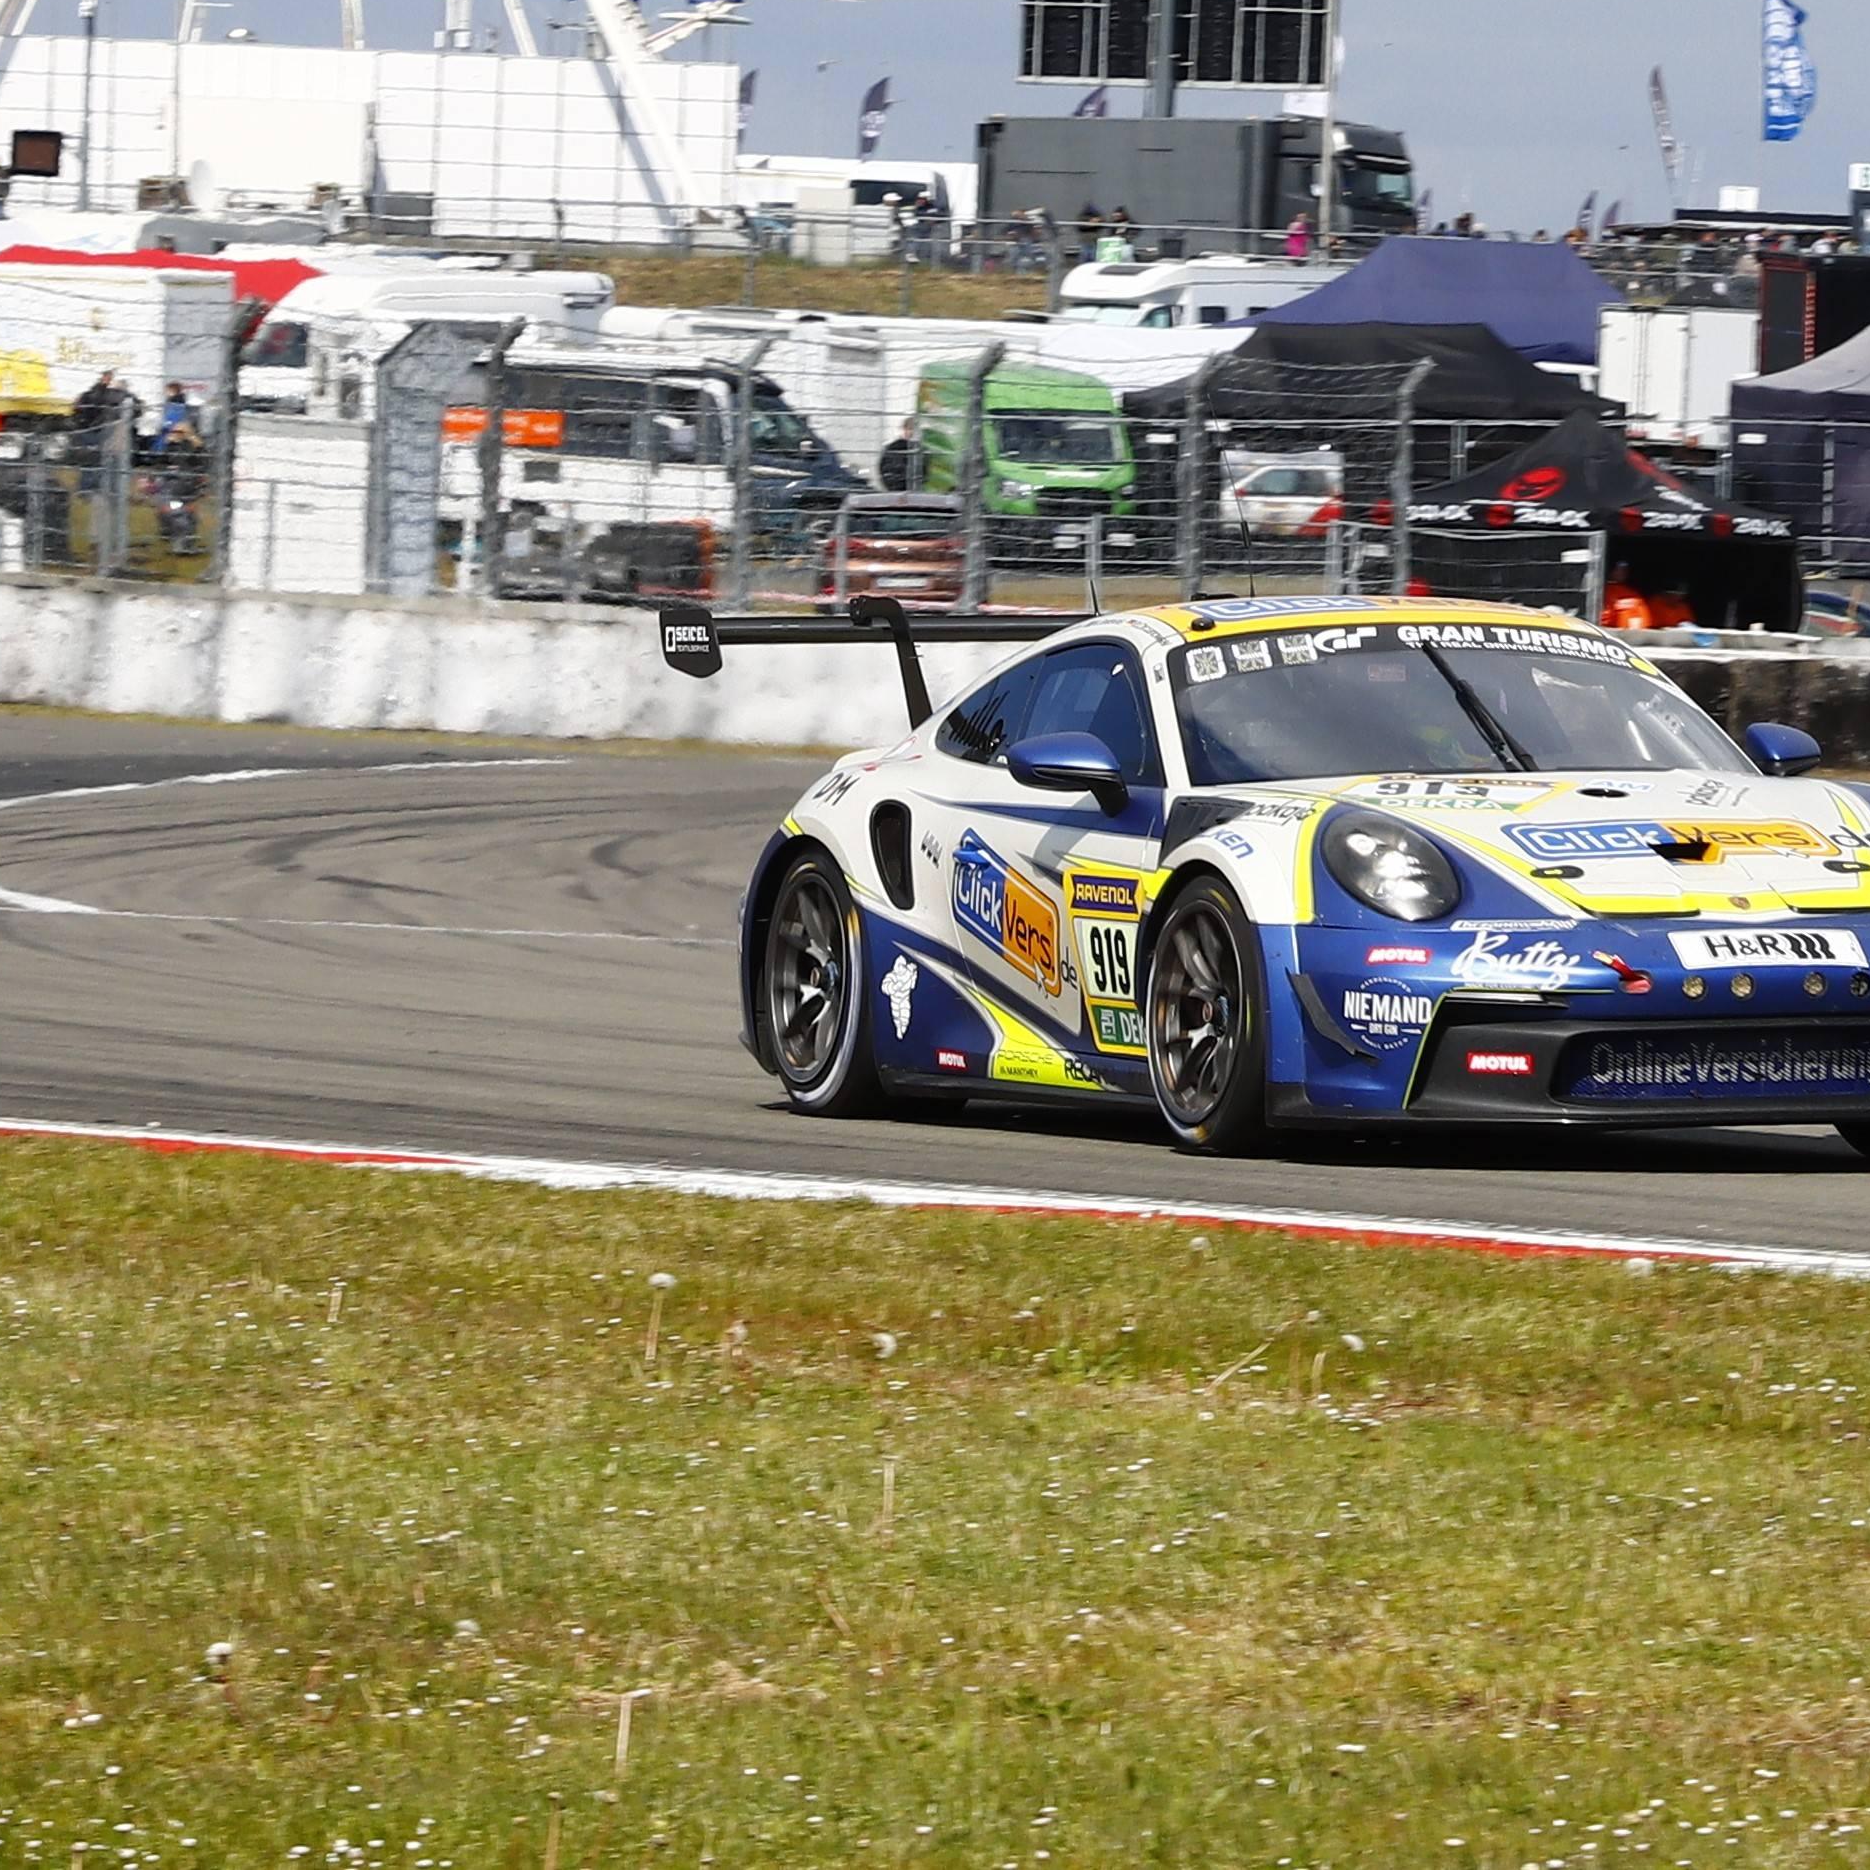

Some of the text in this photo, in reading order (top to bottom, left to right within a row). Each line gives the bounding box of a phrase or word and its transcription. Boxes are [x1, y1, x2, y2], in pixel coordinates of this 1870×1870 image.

[1397, 625, 1628, 661] GRAN TURISMO
[1440, 641, 1482, 650] REAL
[1381, 798, 1503, 811] DEKRA
[1075, 883, 1134, 906] RAVENOL
[1367, 947, 1428, 963] MOTUL
[1705, 934, 1786, 959] H&R
[1090, 926, 1130, 995] 919
[1344, 990, 1433, 1024] NIEMAND
[1119, 1011, 1149, 1045] DEK
[1469, 1054, 1530, 1071] MOTUL
